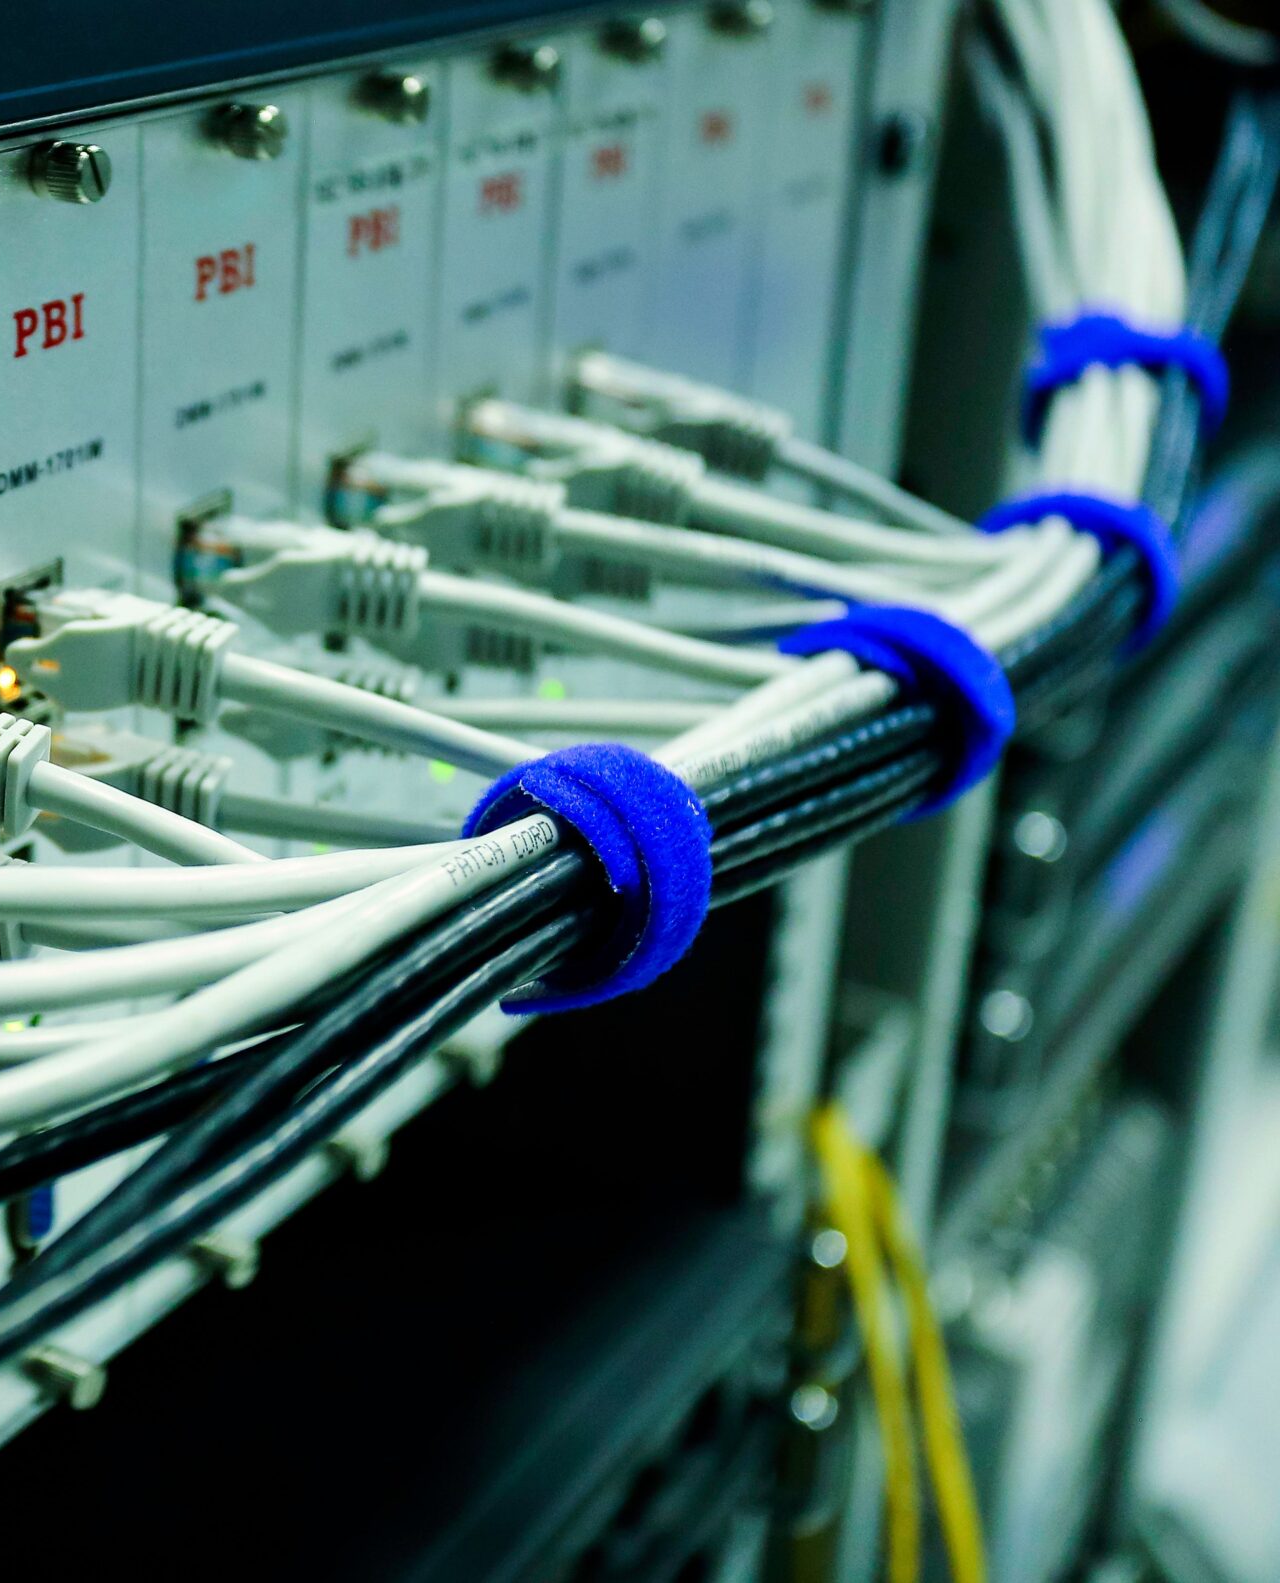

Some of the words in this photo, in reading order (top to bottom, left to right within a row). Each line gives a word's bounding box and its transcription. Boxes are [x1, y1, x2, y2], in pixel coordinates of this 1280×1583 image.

[194, 243, 256, 302] PBI
[12, 292, 86, 359] PBI
[441, 840, 506, 887] PATCH
[510, 821, 554, 860] CORD
